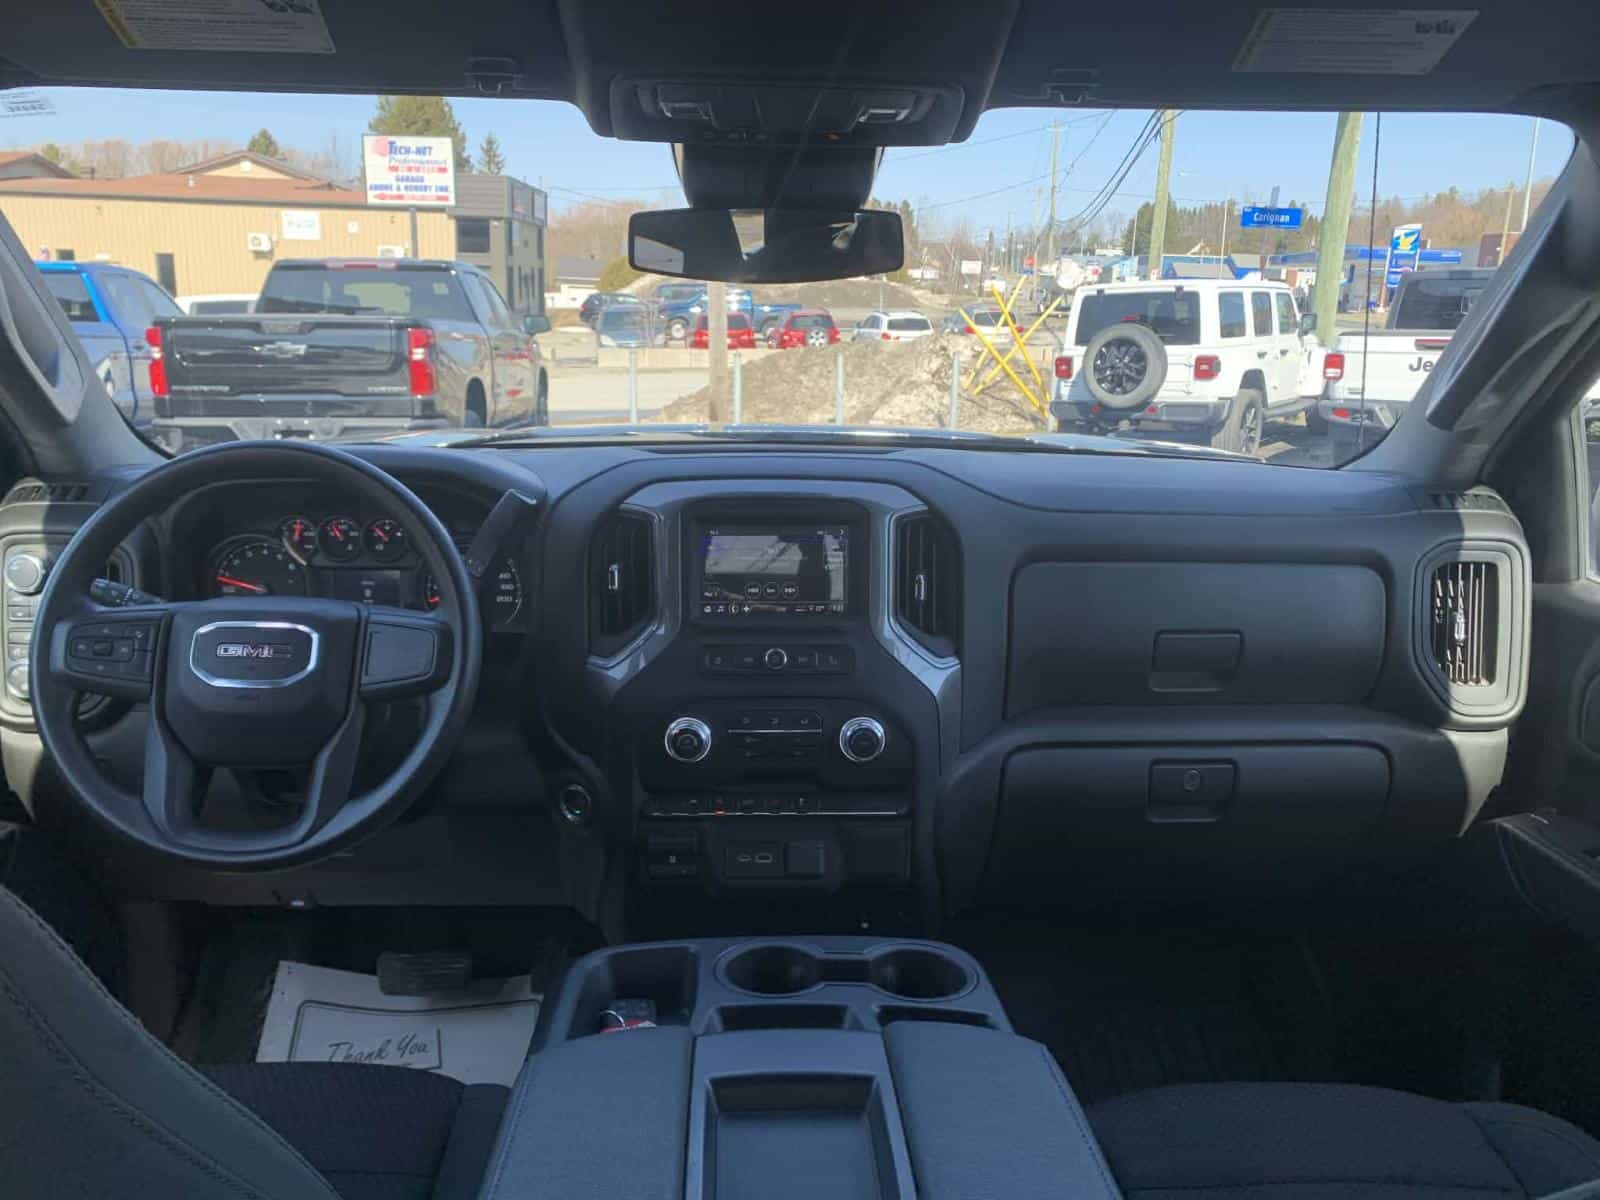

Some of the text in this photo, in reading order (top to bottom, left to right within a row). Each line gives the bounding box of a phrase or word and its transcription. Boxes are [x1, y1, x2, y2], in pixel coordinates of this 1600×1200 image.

[1253, 211, 1291, 225] Carignan
[1408, 356, 1434, 372] Je
[328, 1033, 430, 1062] Thank You
